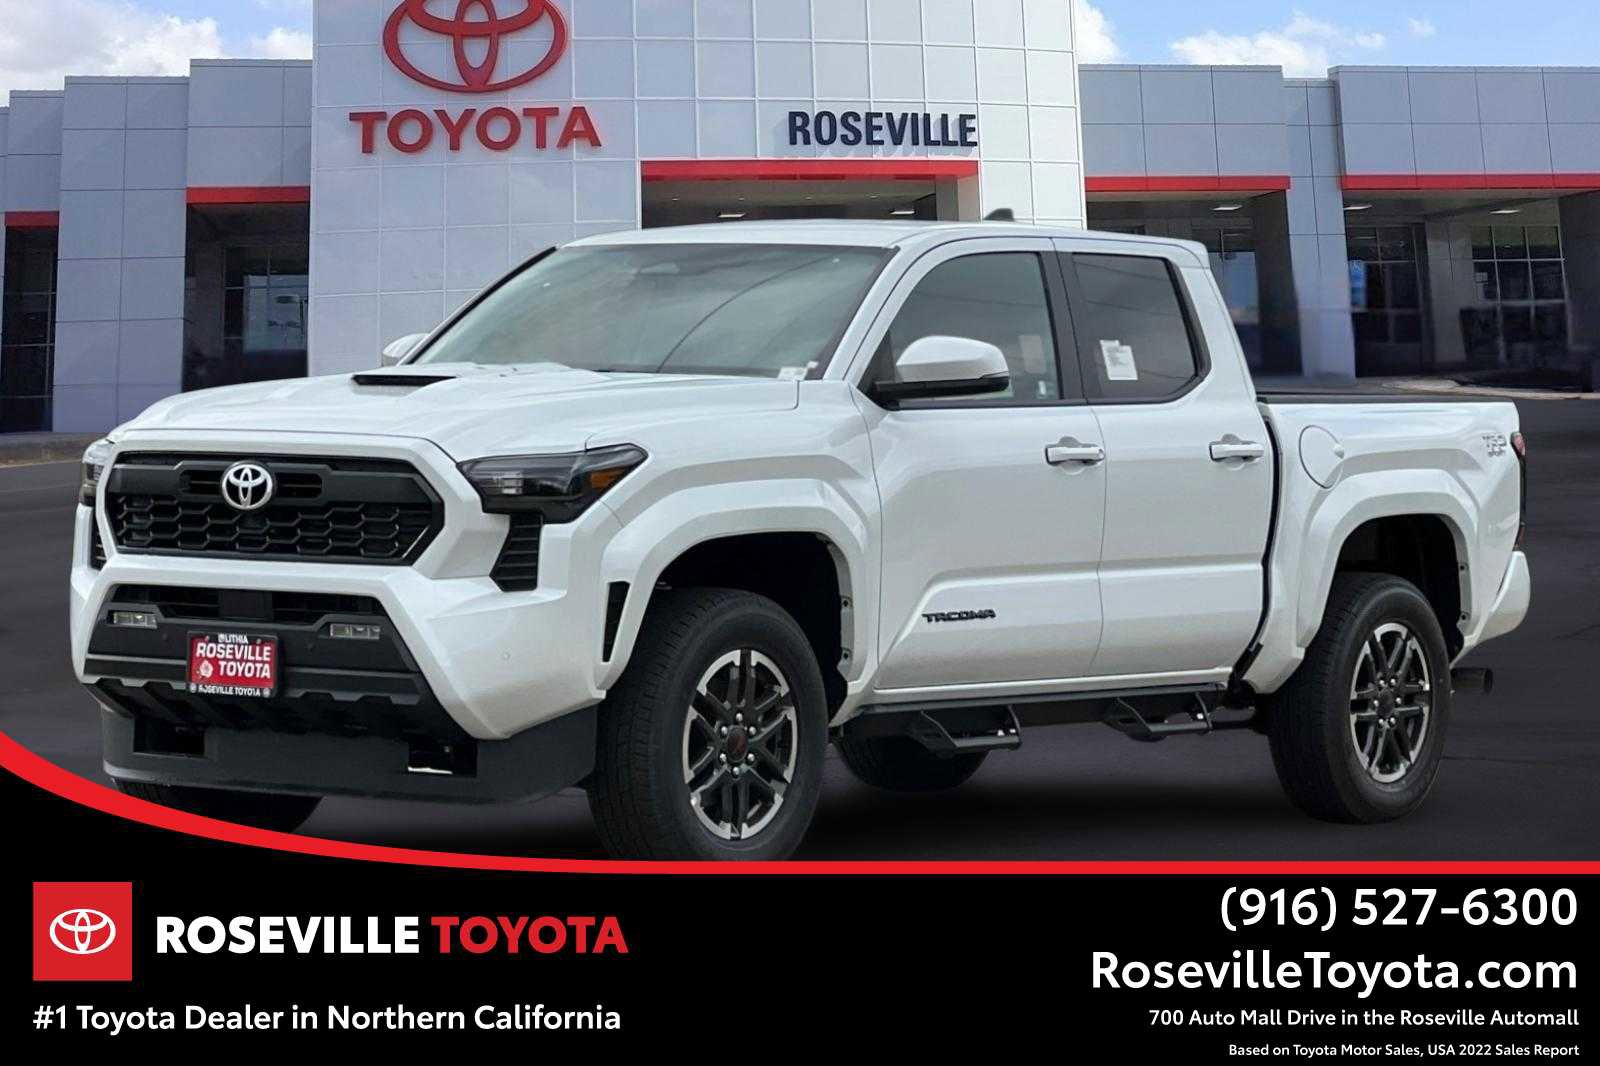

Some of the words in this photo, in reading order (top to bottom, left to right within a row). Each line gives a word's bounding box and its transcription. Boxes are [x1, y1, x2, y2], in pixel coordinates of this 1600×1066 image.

[349, 106, 602, 154] TOYOTA
[788, 111, 978, 147] ROSEVILLE
[921, 609, 996, 623] TACOMA
[196, 642, 272, 661] ROSEVILLE
[218, 660, 271, 679] TOYOTA
[235, 687, 260, 697] TOYOTA
